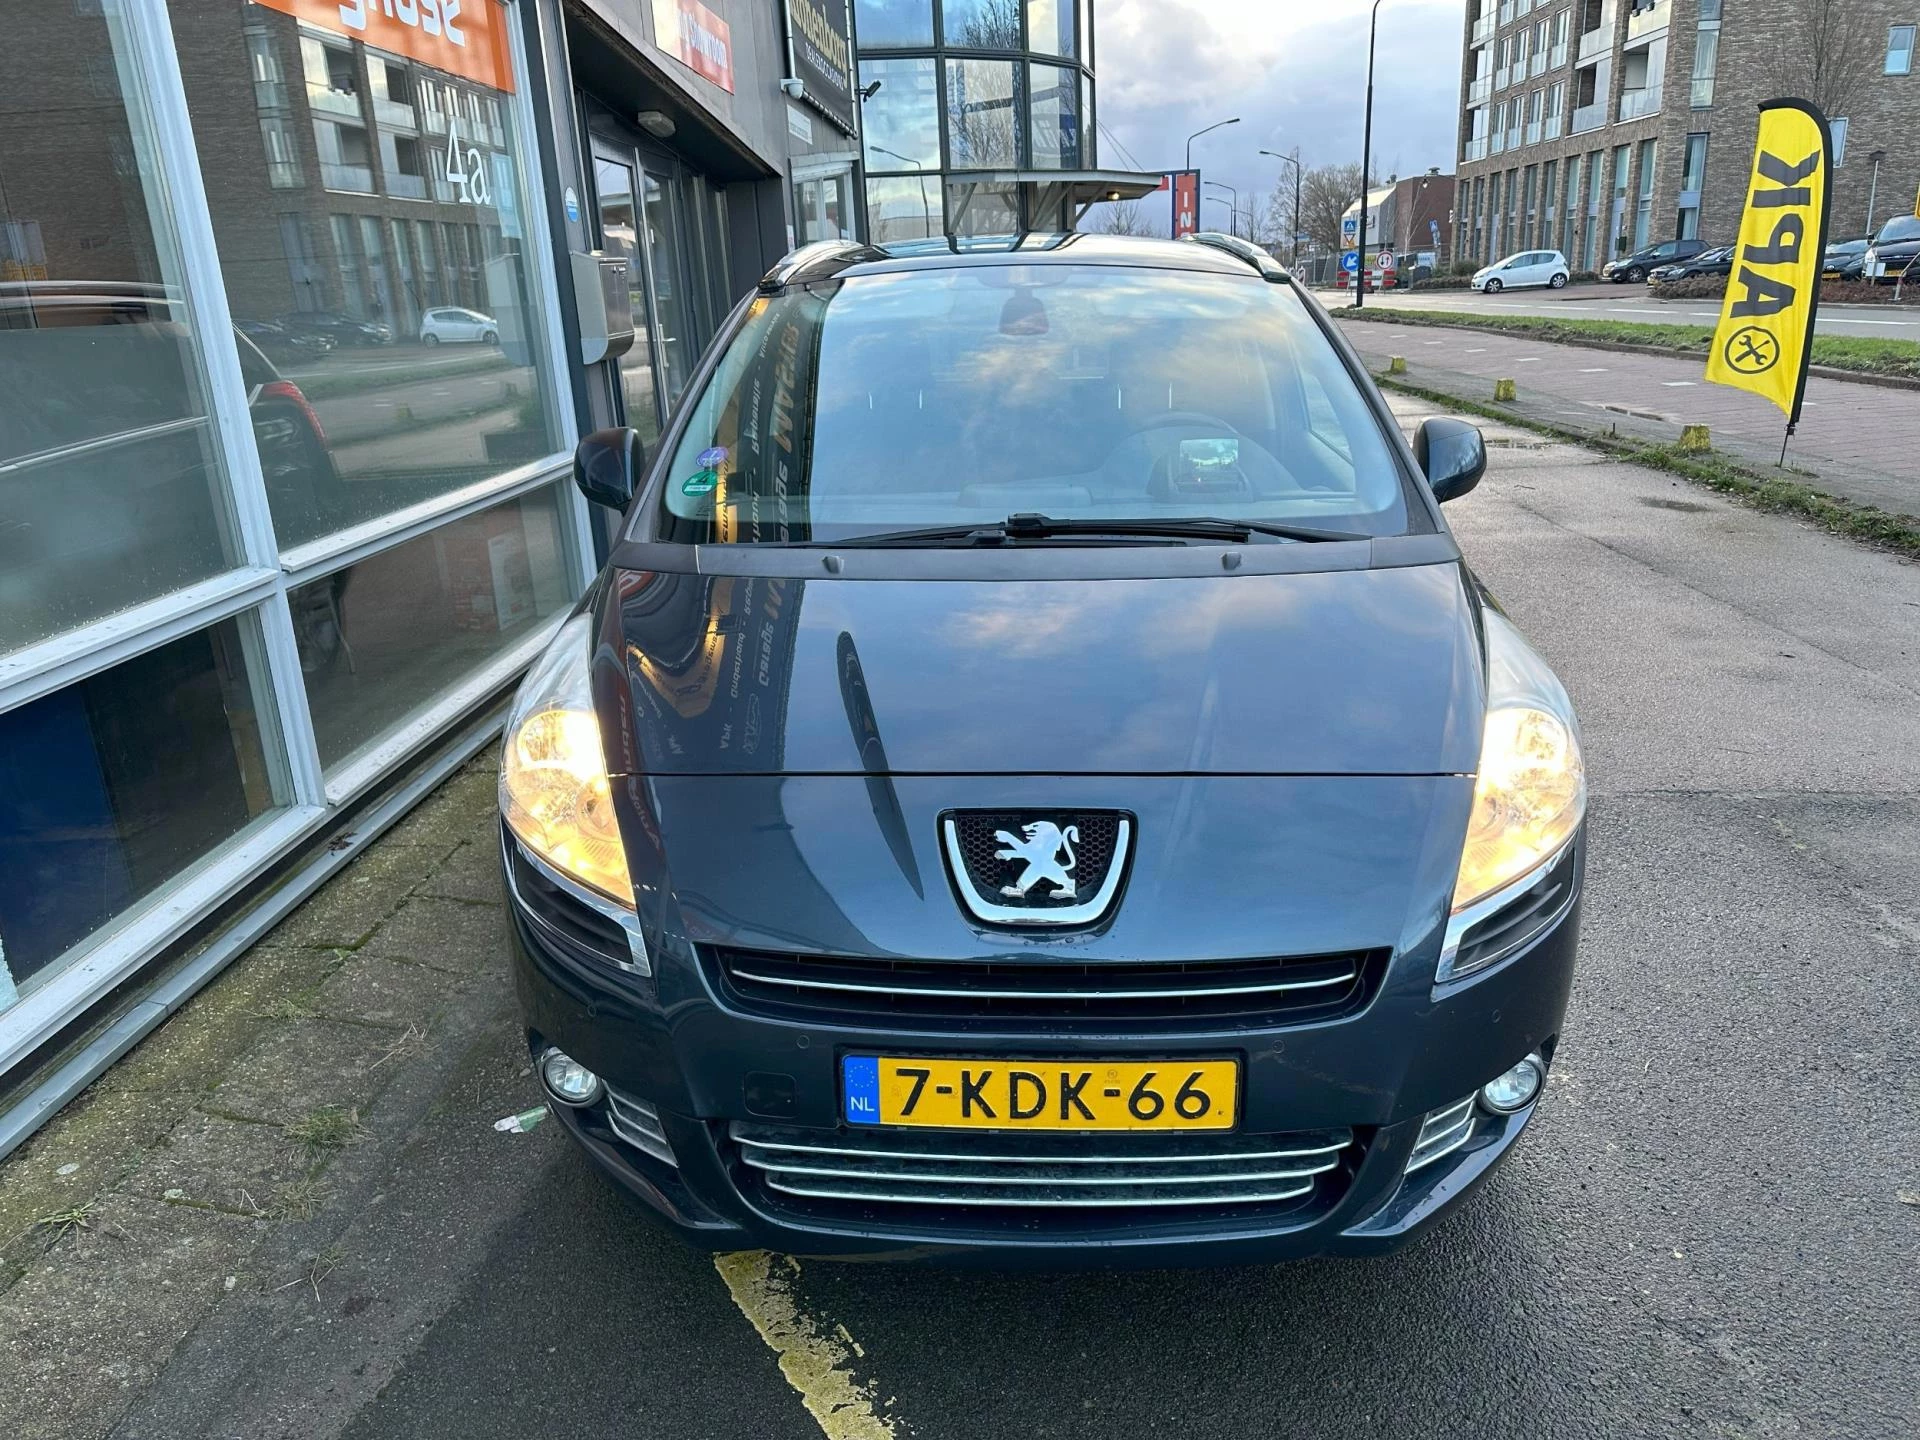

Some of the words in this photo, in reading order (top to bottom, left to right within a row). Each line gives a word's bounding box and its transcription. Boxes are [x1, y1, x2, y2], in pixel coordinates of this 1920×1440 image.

[446, 120, 491, 205] 4a
[1180, 191, 1192, 238] IN
[850, 1096, 875, 1112] NL
[895, 1067, 1211, 1121] 7-KDK-66
